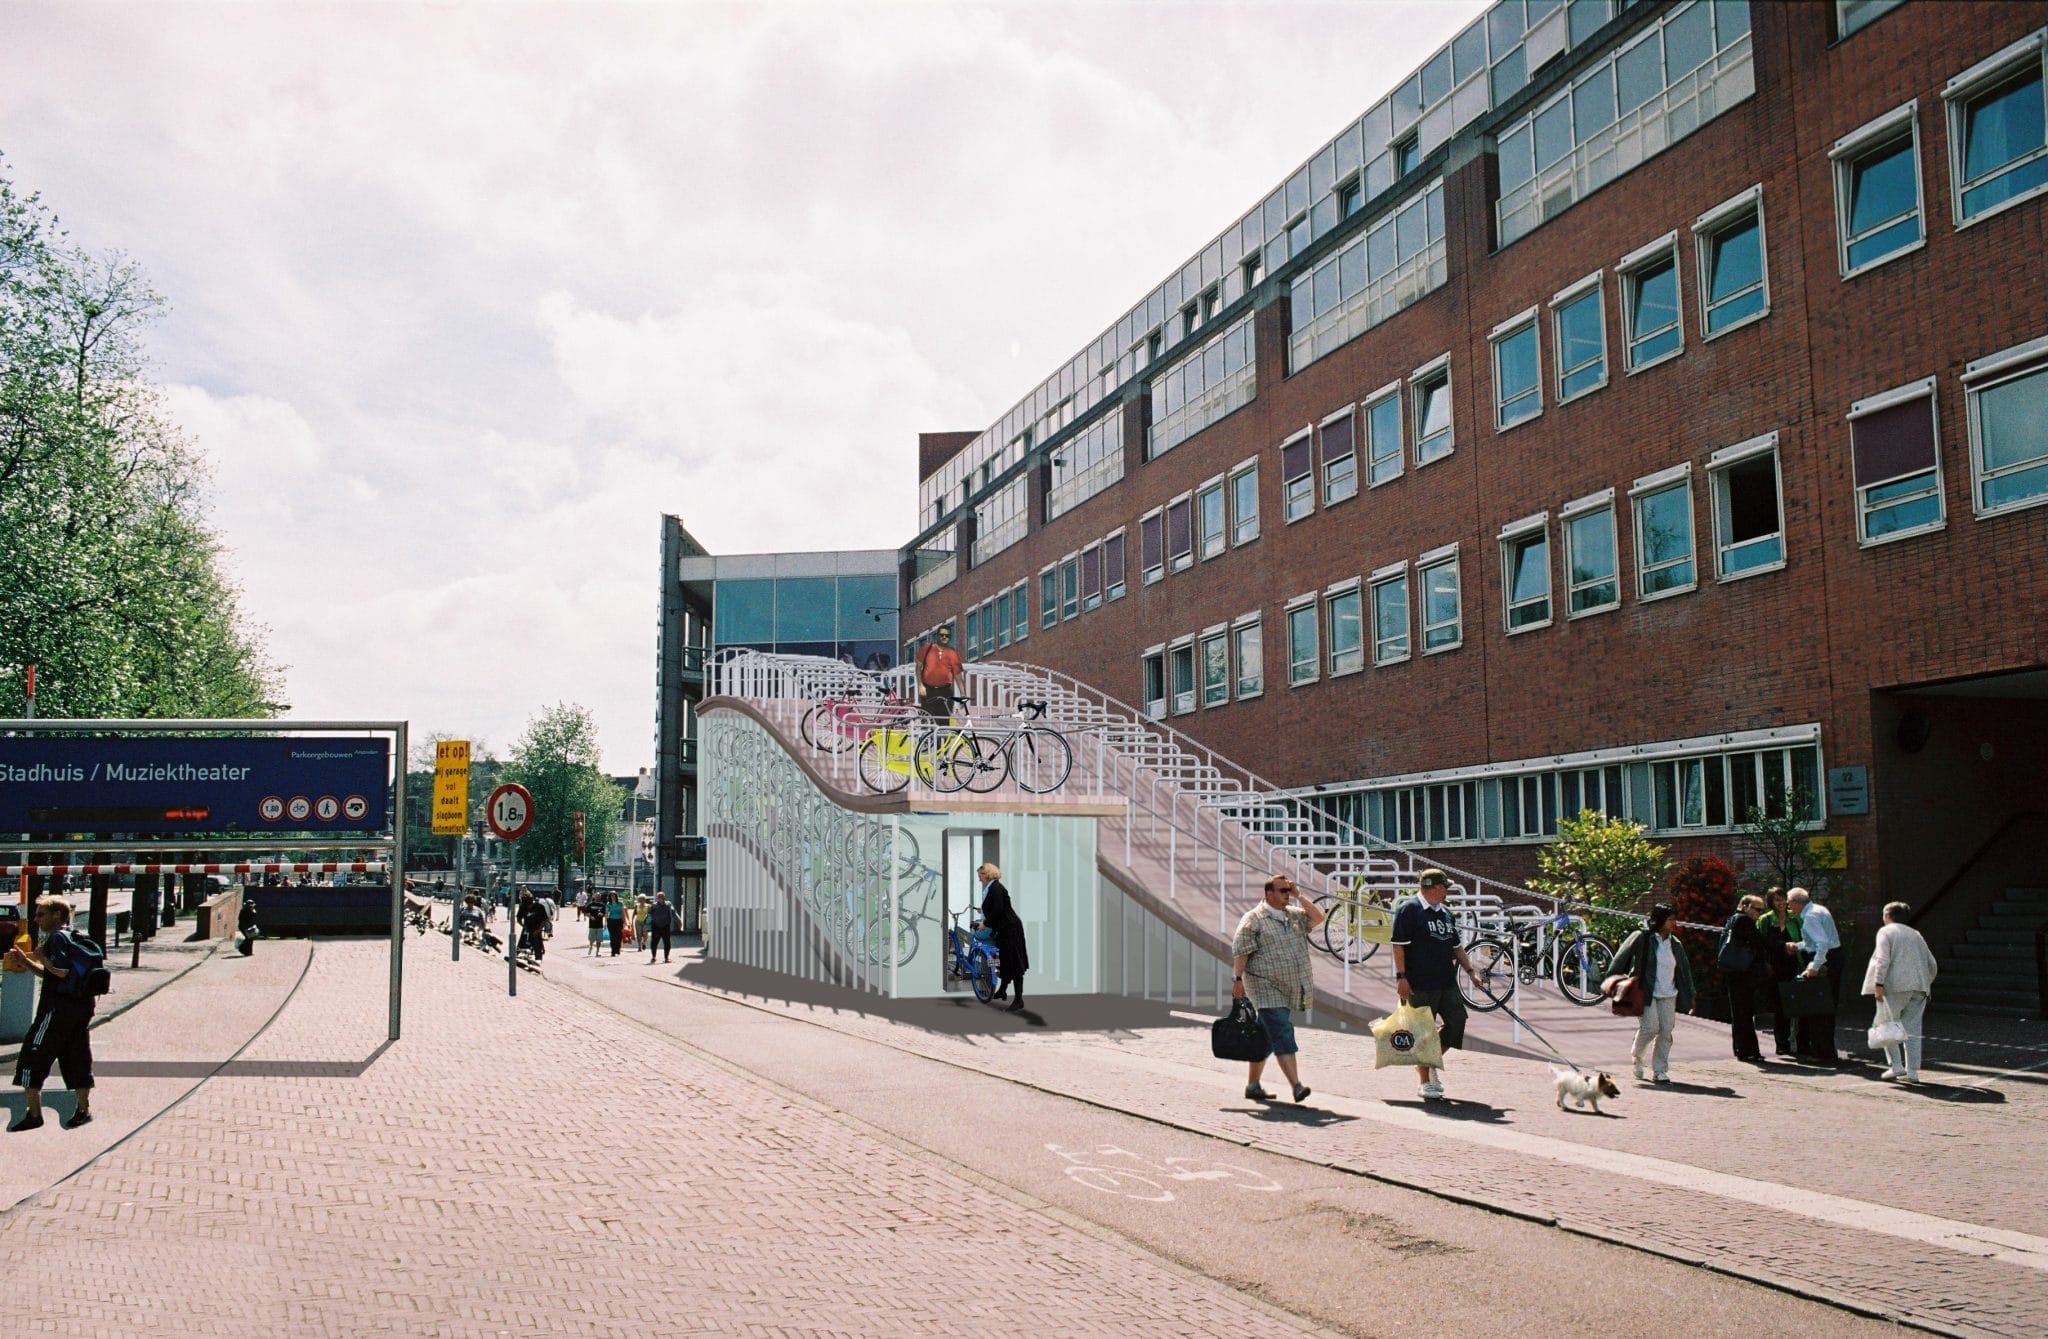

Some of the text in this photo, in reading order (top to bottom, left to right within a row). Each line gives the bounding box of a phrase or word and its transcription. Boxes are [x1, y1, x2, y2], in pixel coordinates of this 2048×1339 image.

[452, 742, 468, 761] op!
[0, 763, 250, 782] Stadhuis / Muziektheater
[445, 768, 467, 778] garage
[441, 796, 459, 805] daalt
[436, 811, 463, 821] slagboom
